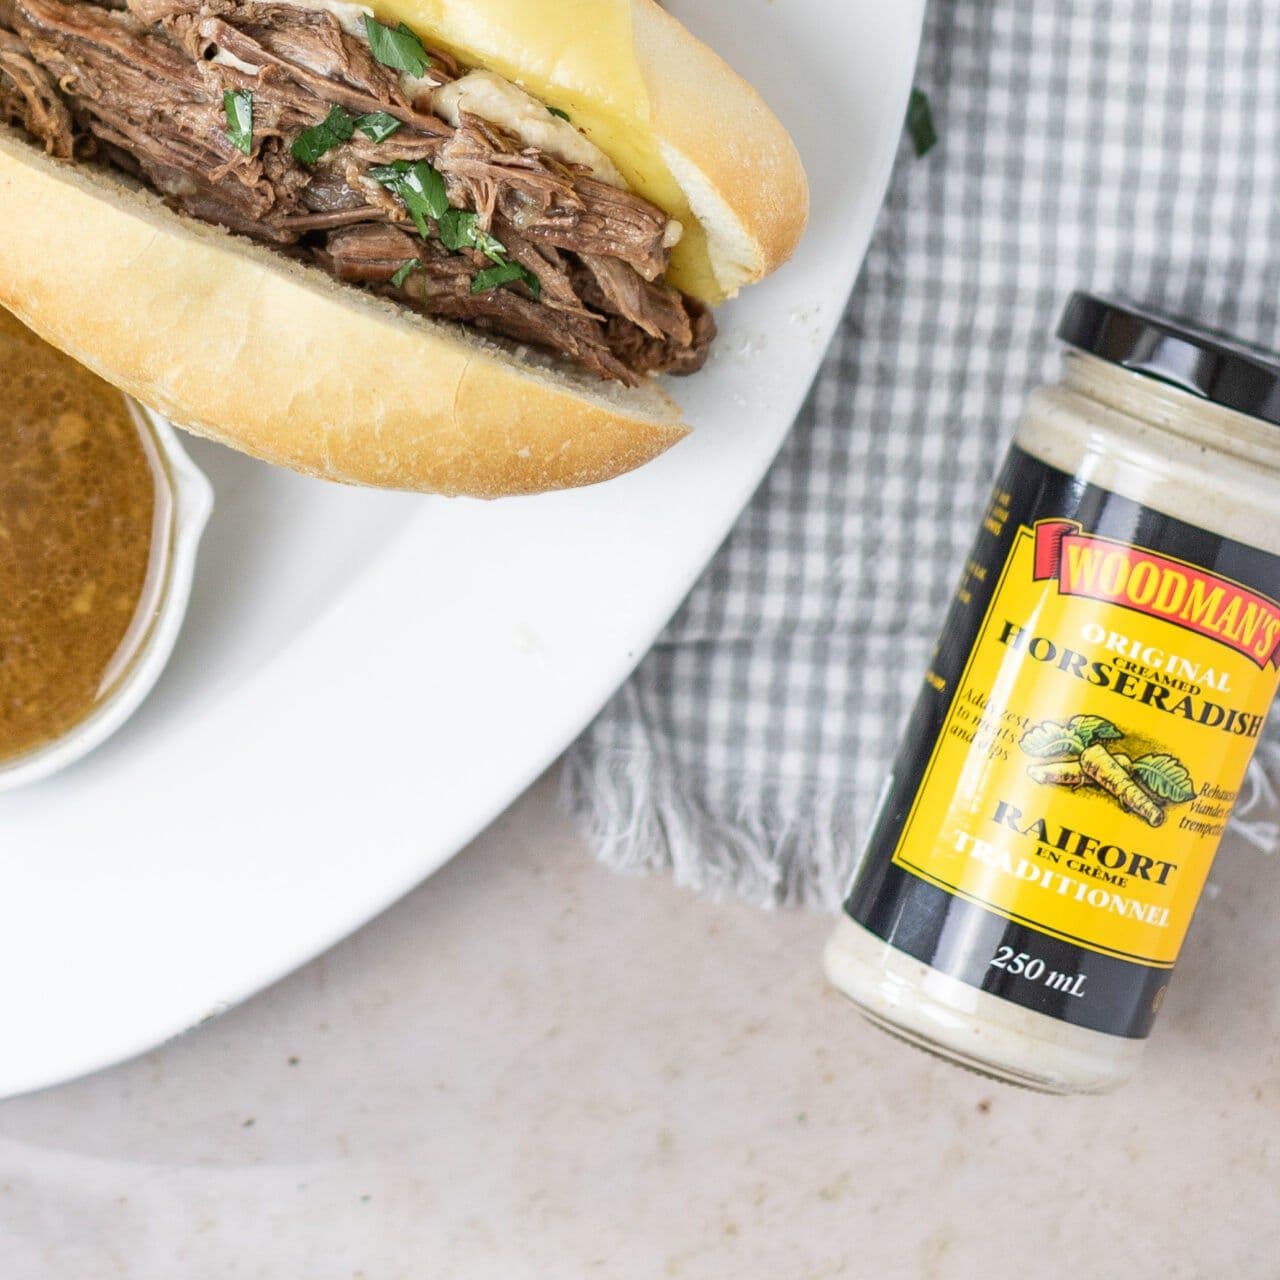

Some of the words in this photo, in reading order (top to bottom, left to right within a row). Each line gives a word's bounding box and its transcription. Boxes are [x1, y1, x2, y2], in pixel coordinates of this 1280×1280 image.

[1067, 544, 1280, 658] WOODMAN'S
[998, 619, 1265, 738] HORSERADISH
[1080, 623, 1231, 694] ORIGINAL
[1112, 656, 1202, 696] CREAMED
[949, 724, 978, 745] and
[956, 704, 970, 721] to
[992, 800, 1178, 886] RAIFORT
[1034, 846, 1062, 864] EN
[1066, 858, 1129, 889] CRÈME
[953, 828, 1170, 928] TRADITIONNEL
[989, 945, 1046, 982] 250
[1044, 969, 1089, 998] mL
